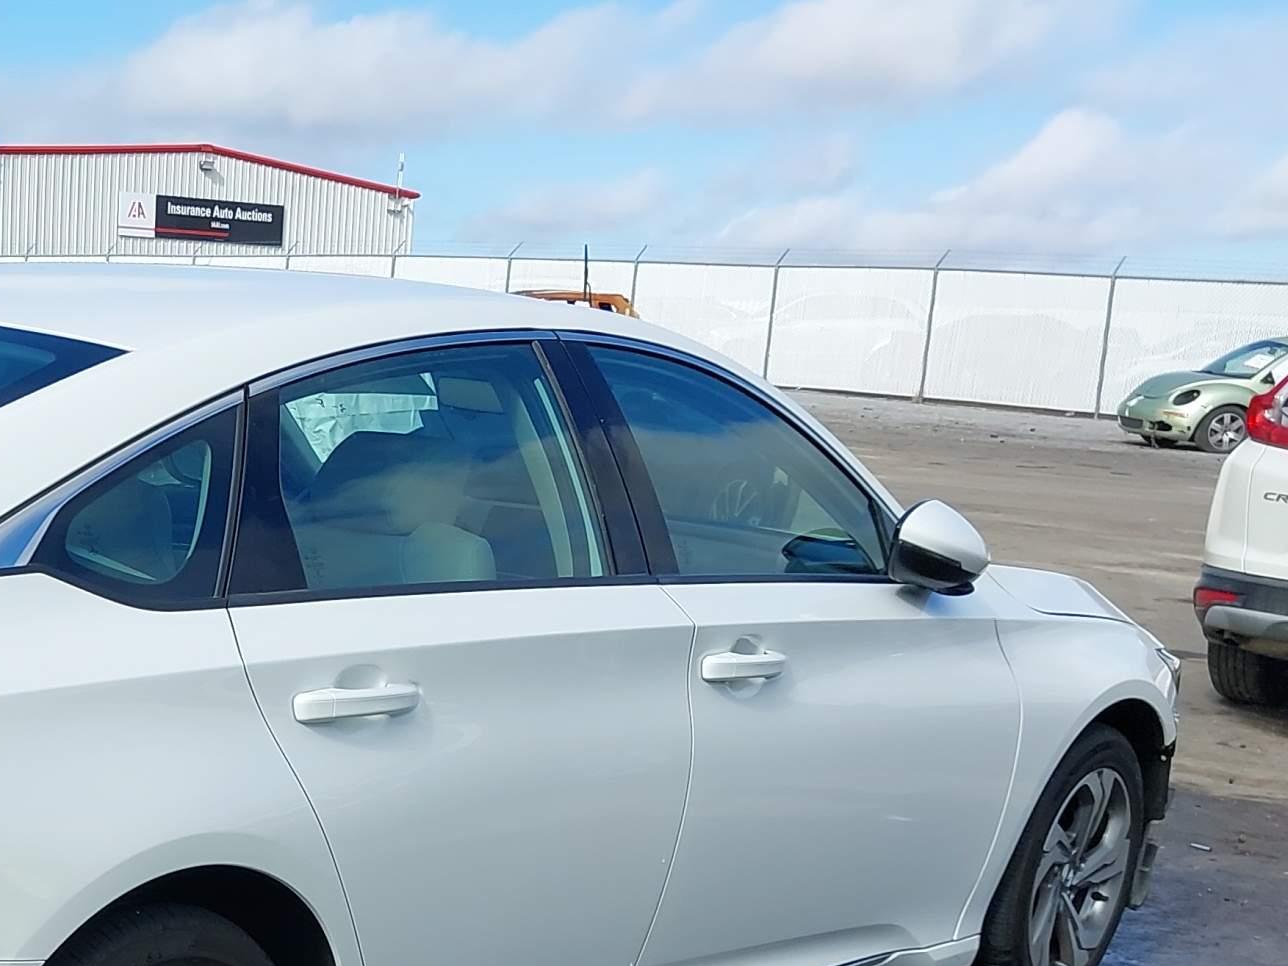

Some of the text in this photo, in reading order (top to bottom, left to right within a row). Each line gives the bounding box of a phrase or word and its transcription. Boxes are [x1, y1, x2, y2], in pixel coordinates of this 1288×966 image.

[167, 201, 273, 223] Insurance Auto Auctions
